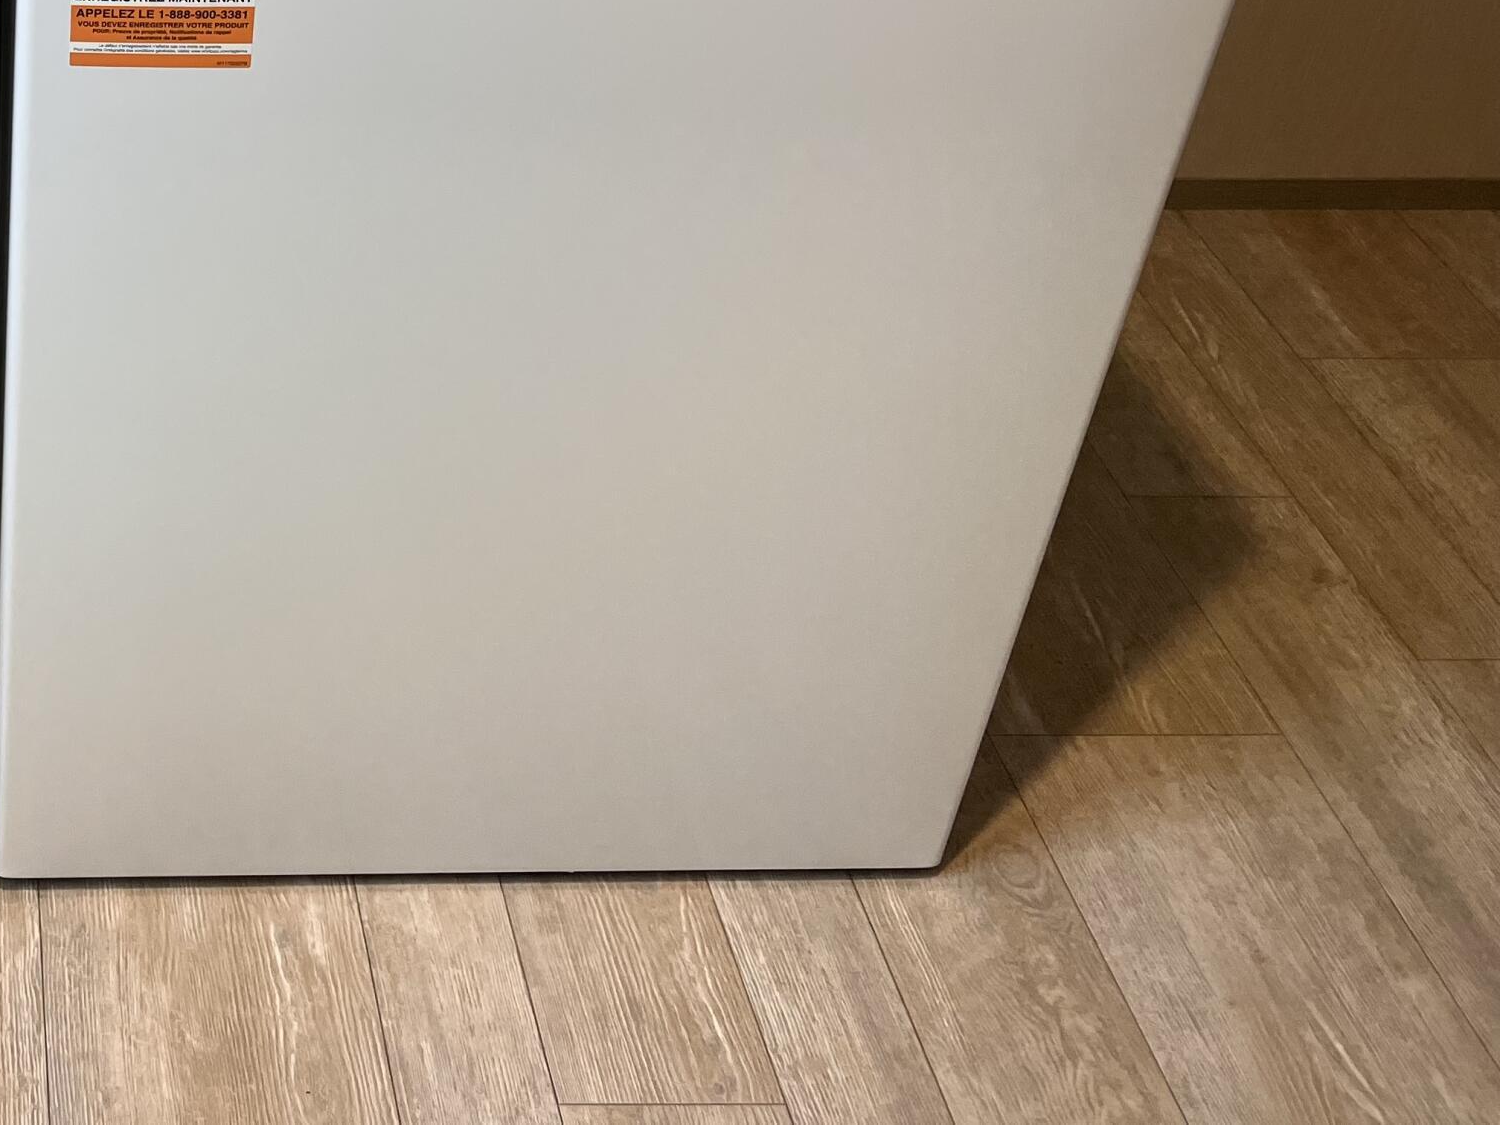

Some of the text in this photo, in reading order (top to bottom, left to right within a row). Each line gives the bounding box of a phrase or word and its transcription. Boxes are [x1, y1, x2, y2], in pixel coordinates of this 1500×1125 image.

[76, 9, 248, 20] APPELEZ LE 1-888-900-3381
